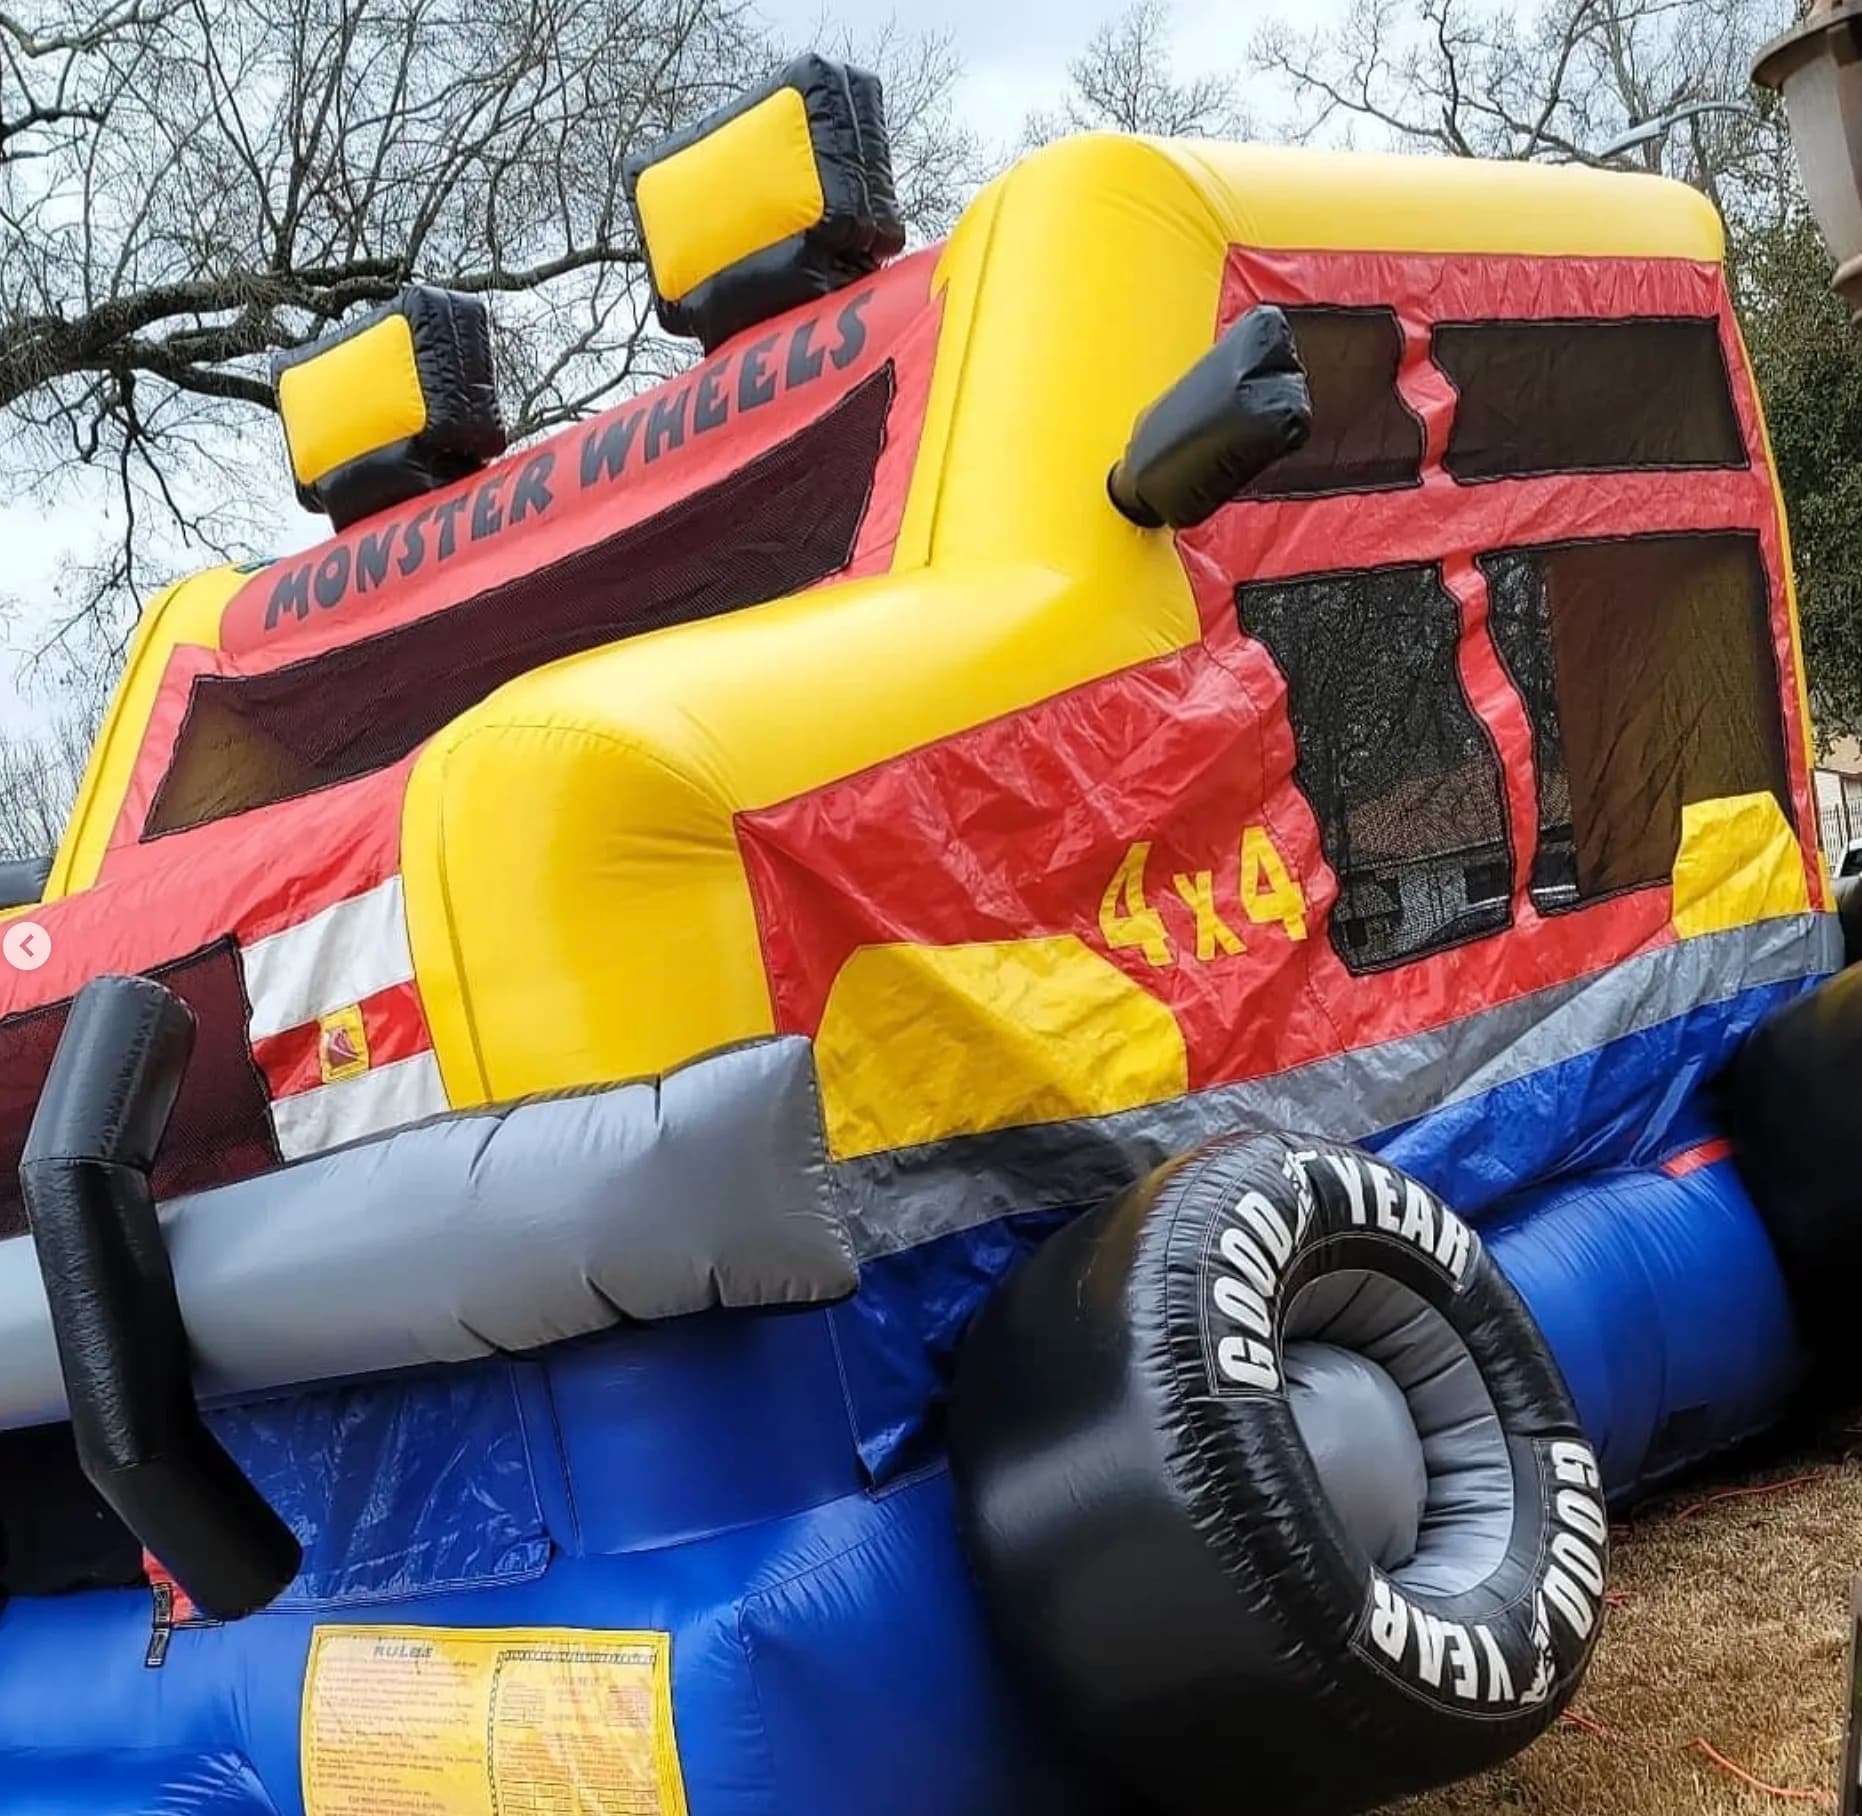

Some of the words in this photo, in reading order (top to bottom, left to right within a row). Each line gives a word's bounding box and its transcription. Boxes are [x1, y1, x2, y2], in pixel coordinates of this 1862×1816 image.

[265, 454, 554, 630] MONSTER
[580, 289, 874, 488] WHEELS
[1214, 1191, 1293, 1392] GOOD
[1324, 1155, 1471, 1279] YEAR
[1371, 1579, 1514, 1701] YEAR
[1543, 1441, 1607, 1640] GOOD
